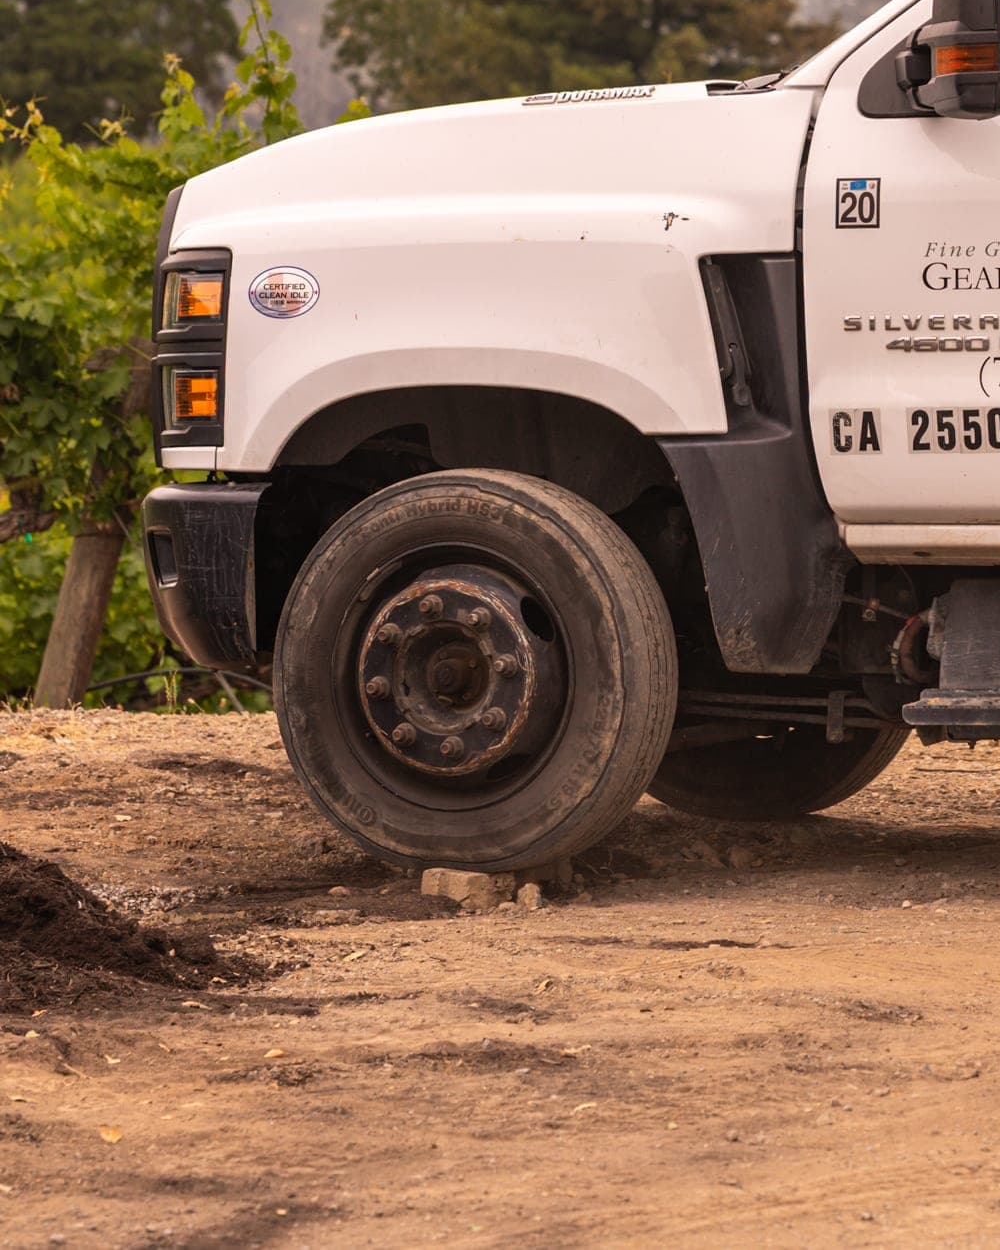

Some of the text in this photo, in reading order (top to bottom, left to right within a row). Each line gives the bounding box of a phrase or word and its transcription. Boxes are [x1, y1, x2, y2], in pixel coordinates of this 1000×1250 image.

[557, 86, 656, 104] DURAMAX
[838, 192, 877, 224] 20
[924, 241, 976, 258] Fine
[258, 291, 309, 299] CLEAN IDLE
[885, 336, 990, 353] 4500
[831, 410, 881, 452] CA
